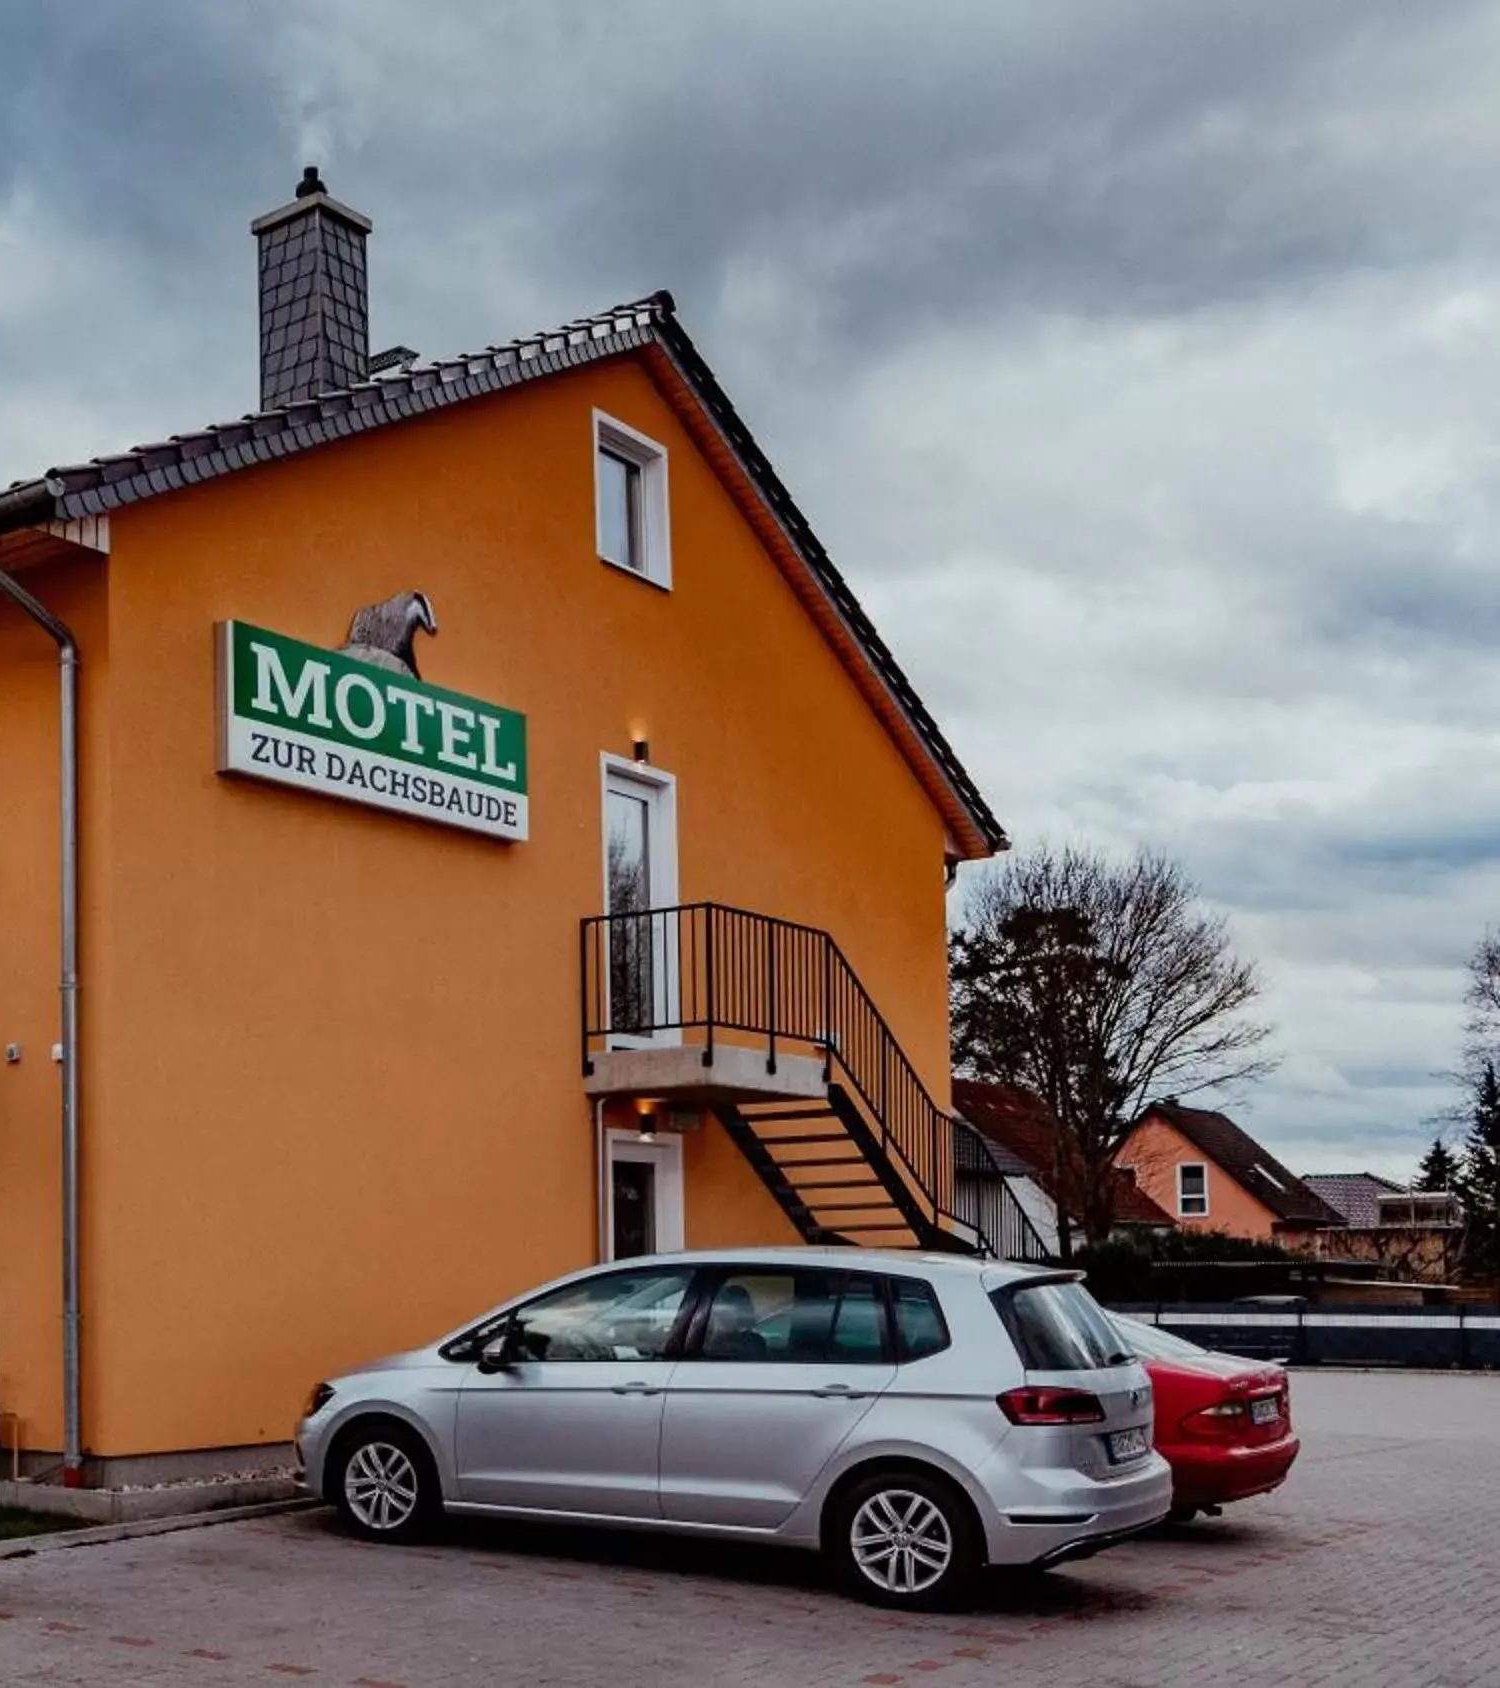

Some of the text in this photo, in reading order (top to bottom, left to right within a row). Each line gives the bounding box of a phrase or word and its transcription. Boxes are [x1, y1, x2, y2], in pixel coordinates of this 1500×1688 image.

[250, 641, 517, 781] MOTEL
[251, 732, 518, 827] ZUR DACHSBAUDE
